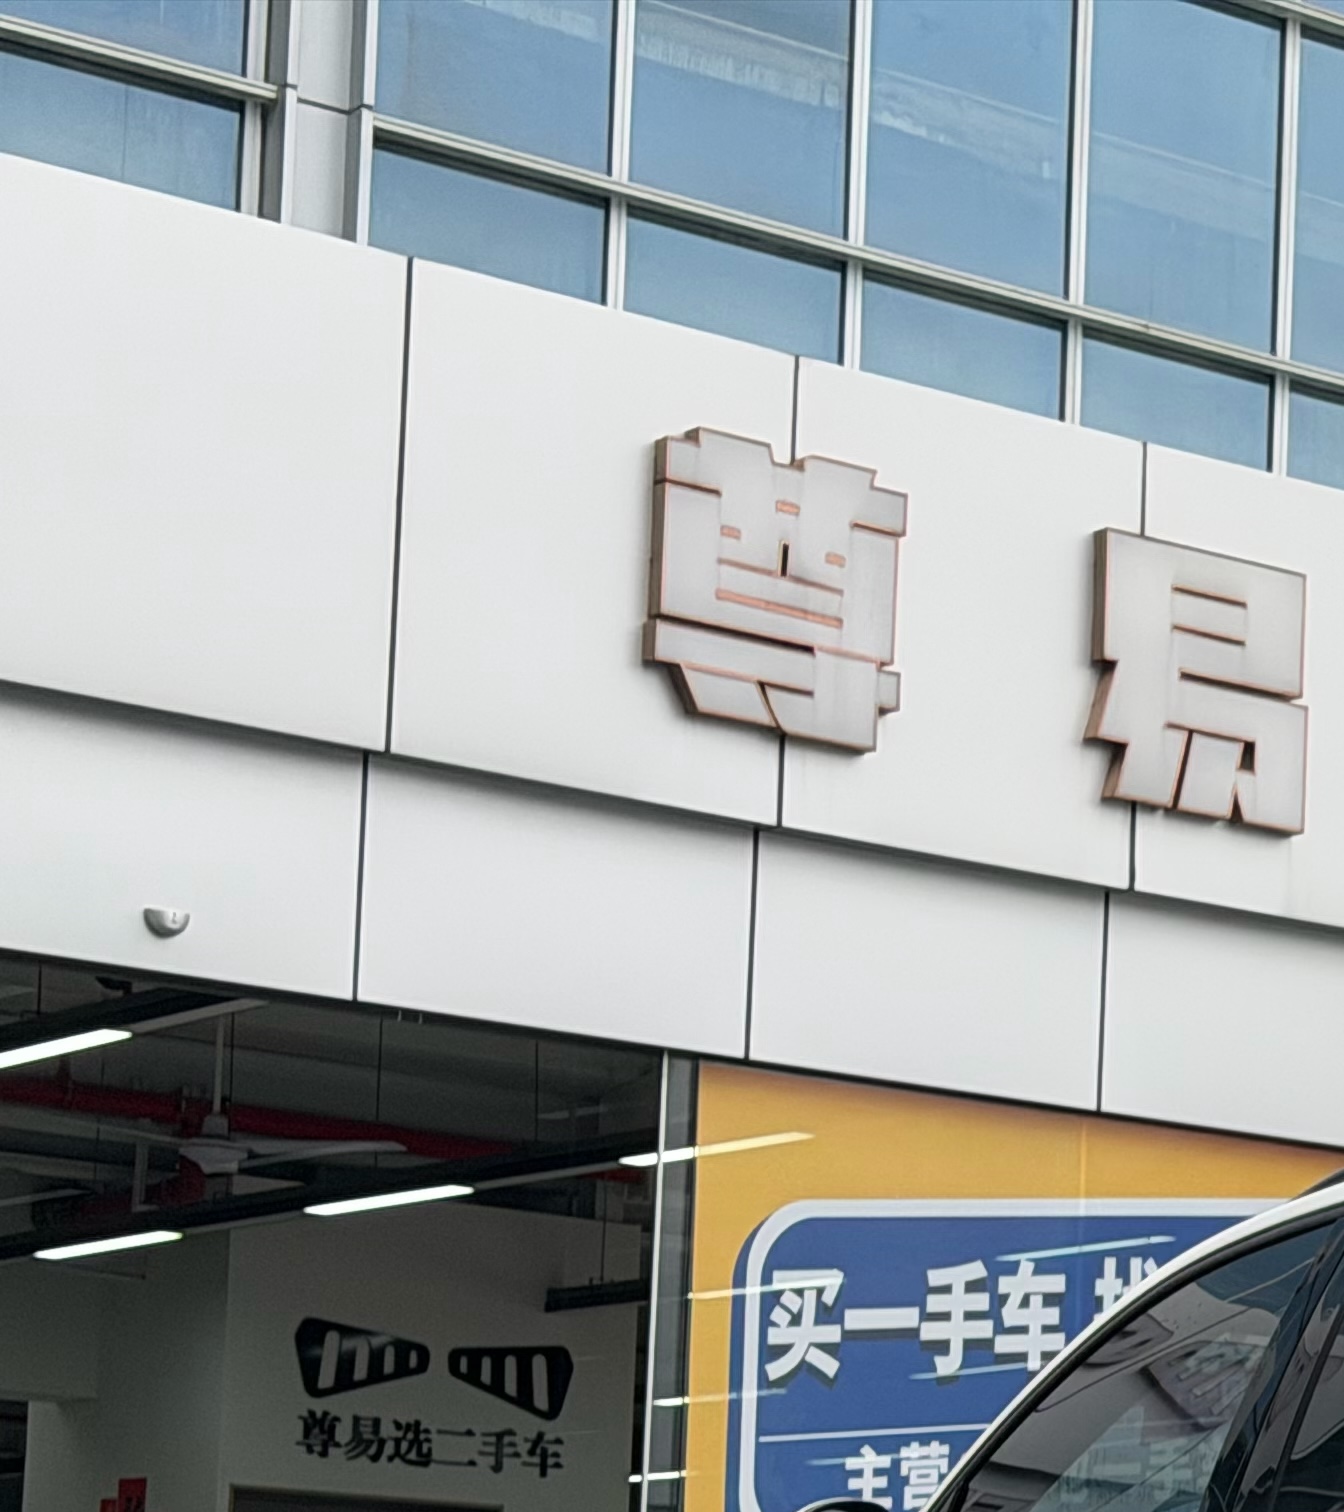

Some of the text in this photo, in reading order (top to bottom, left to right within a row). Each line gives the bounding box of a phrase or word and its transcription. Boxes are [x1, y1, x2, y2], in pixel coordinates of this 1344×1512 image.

[295, 1407, 565, 1479] 尊易选二手车
